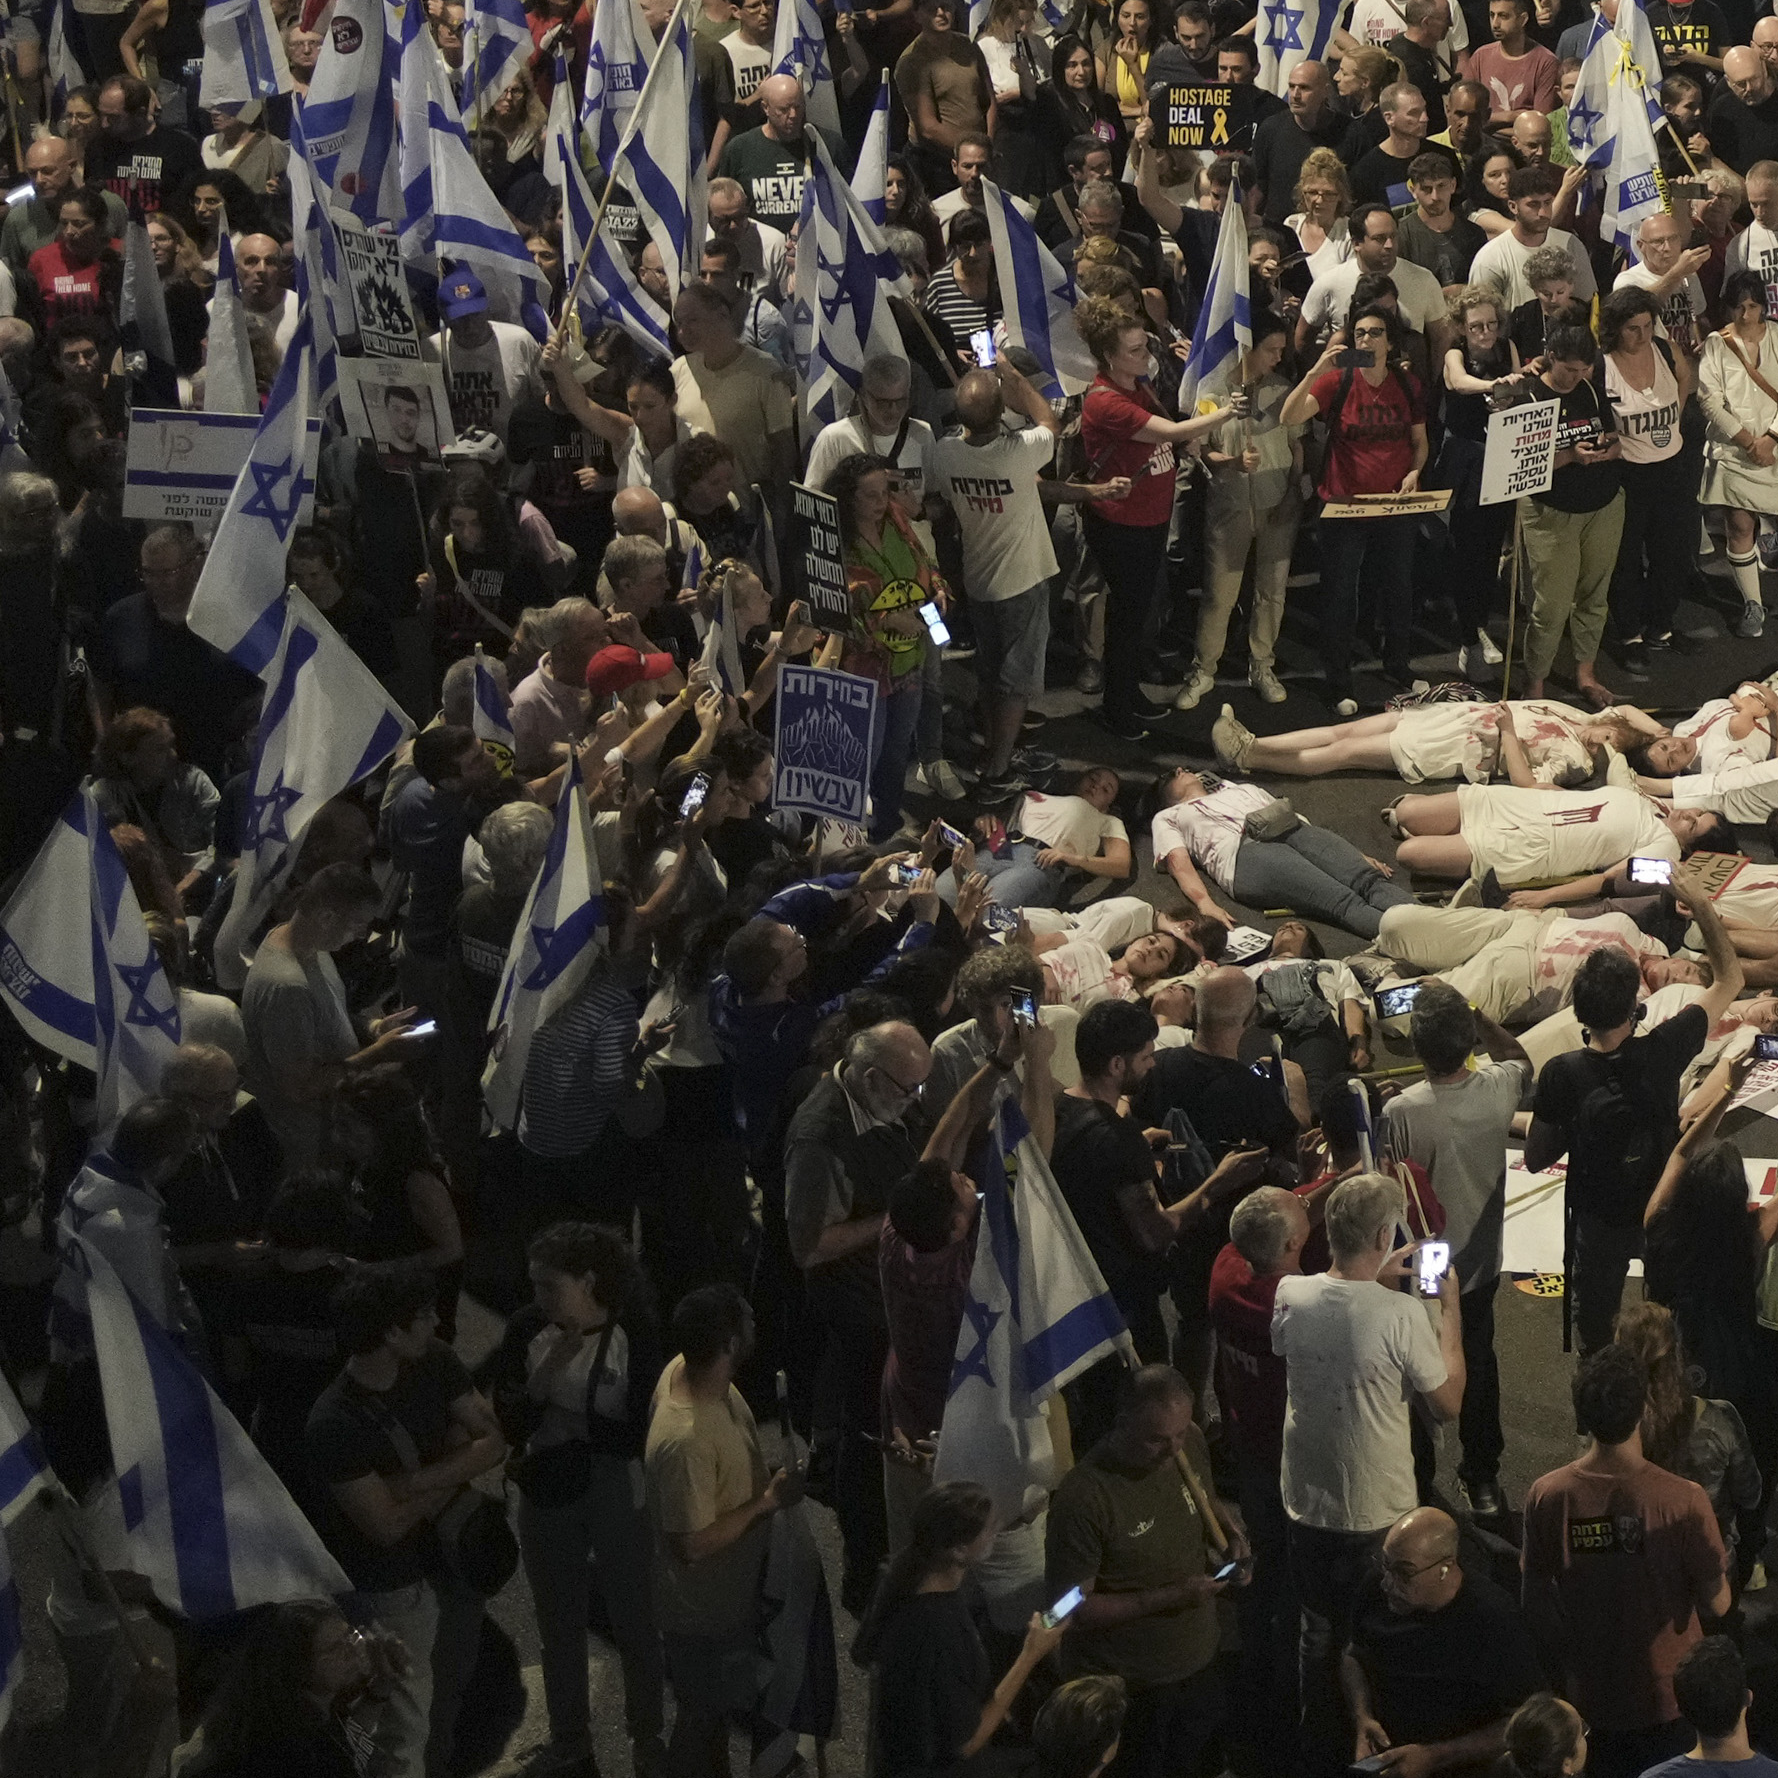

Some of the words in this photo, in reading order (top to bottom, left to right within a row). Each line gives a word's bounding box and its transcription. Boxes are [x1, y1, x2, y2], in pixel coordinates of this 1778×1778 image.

[1169, 88, 1232, 106] HOSTAGE
[1169, 107, 1204, 124] DEAL
[1168, 126, 1204, 145] NOW
[752, 176, 804, 201] NEVE
[1502, 405, 1554, 428] האחיות
[1519, 416, 1554, 434] שלנו
[1508, 464, 1550, 482] עסקה
[949, 477, 1012, 495] בחירות
[783, 671, 870, 710] בחירות
[782, 768, 859, 812] עכשיו!
[1571, 1523, 1612, 1535] הדחה
[1572, 1535, 1613, 1547] עכשיו
